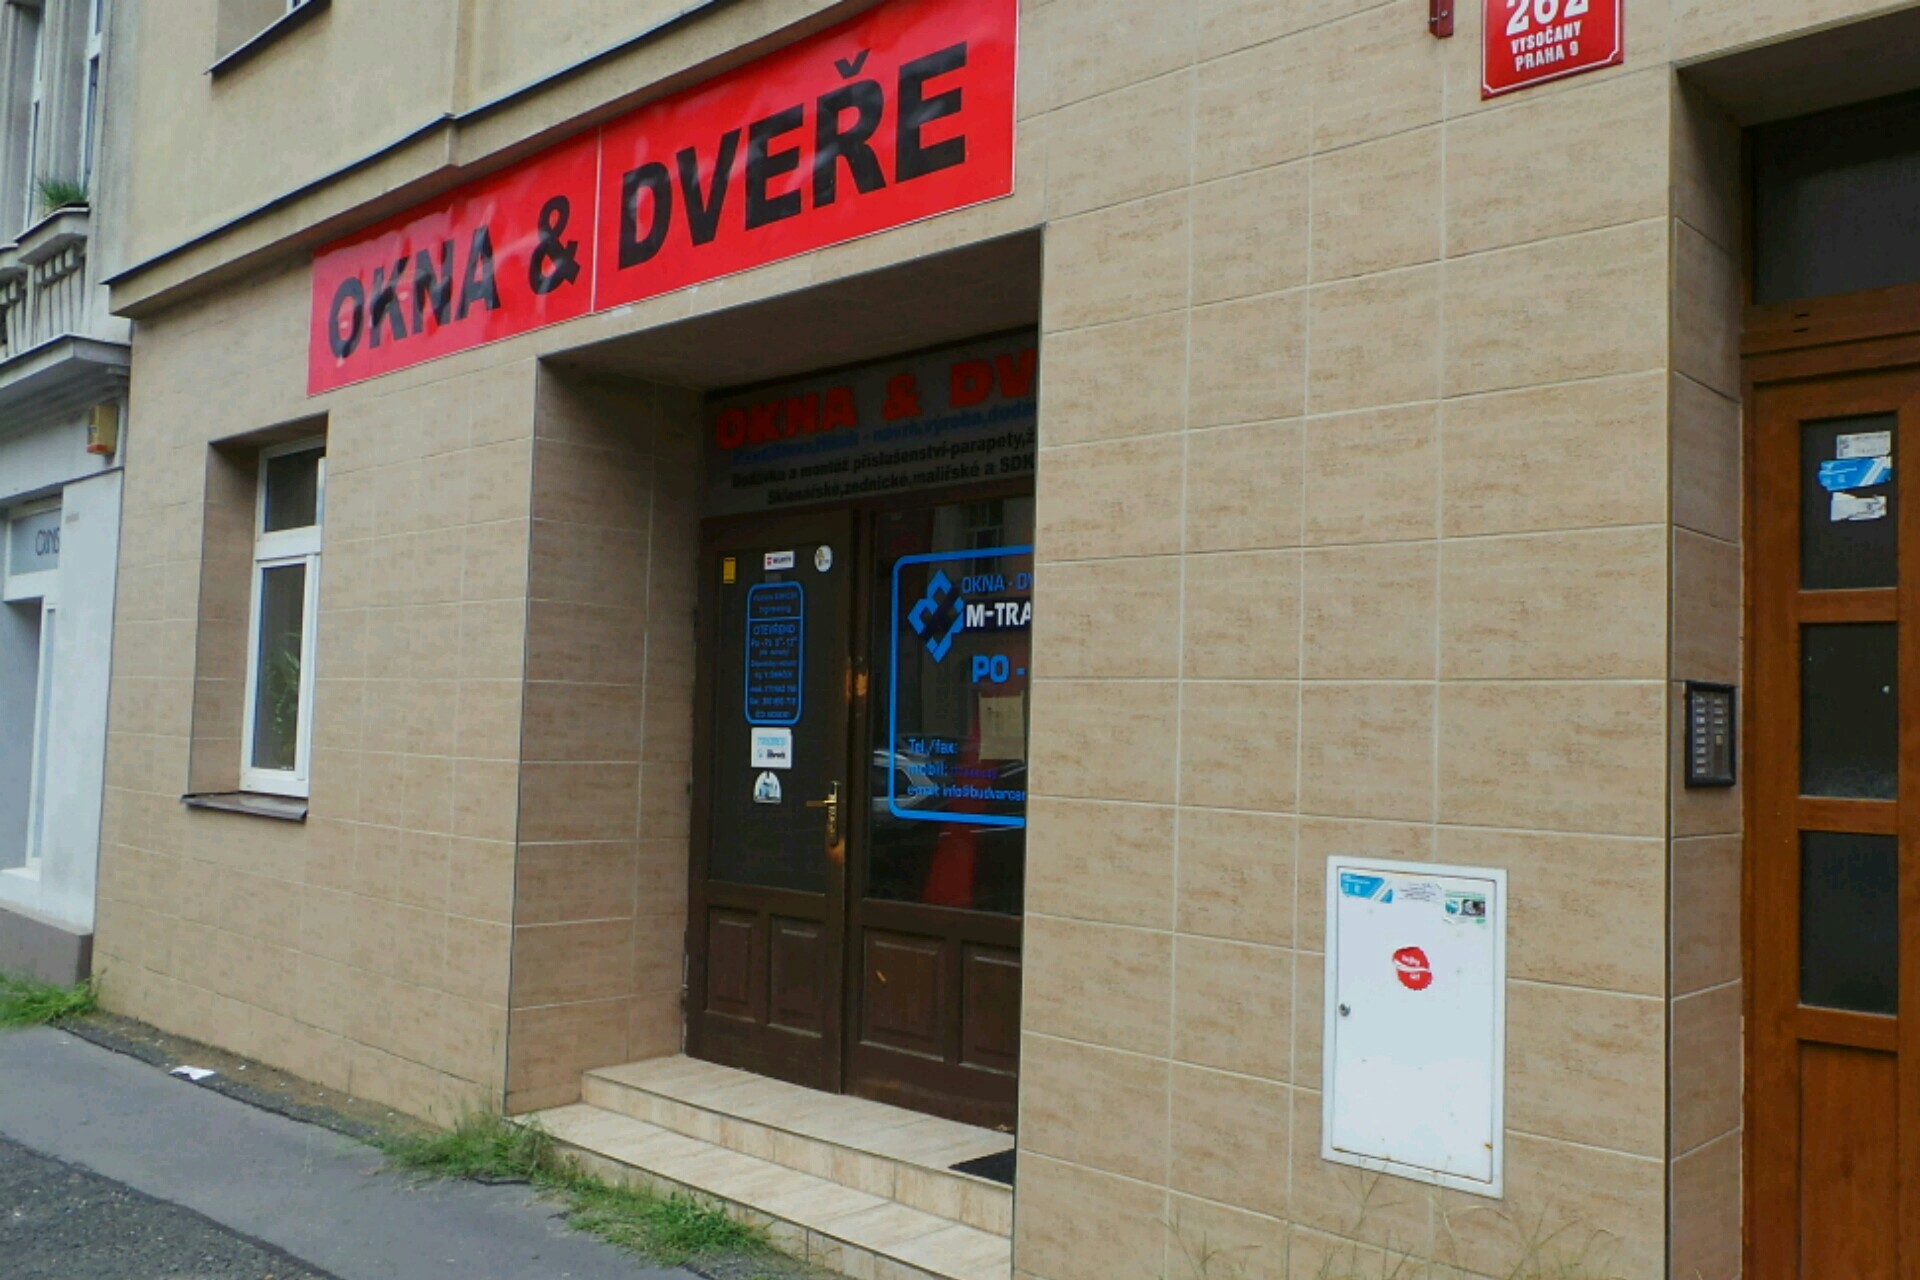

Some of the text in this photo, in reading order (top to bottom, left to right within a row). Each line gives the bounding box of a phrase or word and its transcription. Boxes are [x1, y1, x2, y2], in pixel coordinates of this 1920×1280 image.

[1511, 20, 1583, 54] VYSOČANY
[1514, 41, 1579, 72] PRAHA 9
[327, 41, 968, 360] OKNA & DVEŘE
[718, 387, 857, 449] OKNA
[880, 373, 923, 421] &
[985, 463, 995, 477] a
[961, 574, 1006, 594] OKNA
[965, 601, 1032, 628] M-TRA
[971, 654, 1010, 684] PO
[907, 762, 948, 777] mobil:
